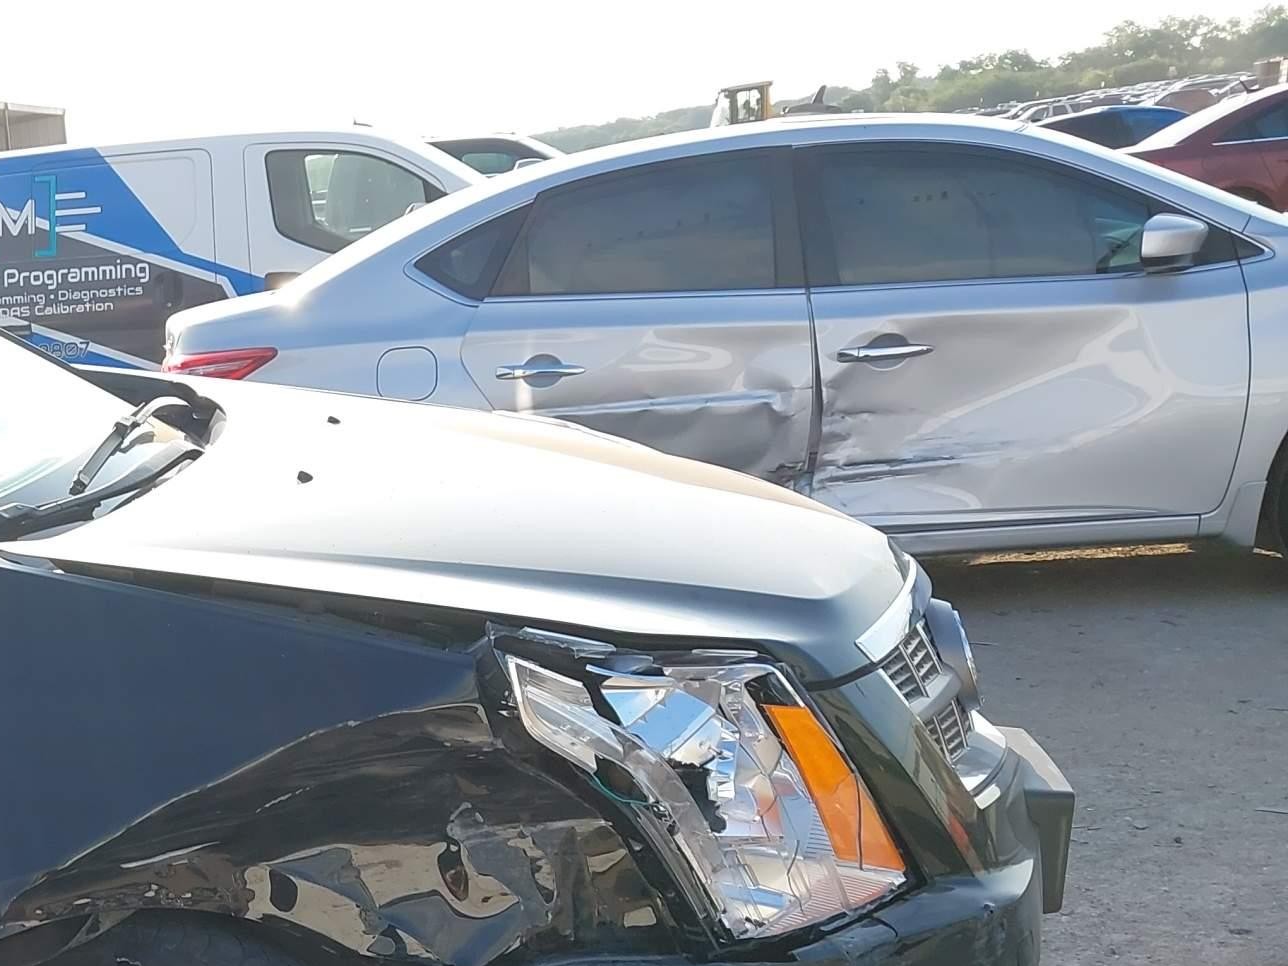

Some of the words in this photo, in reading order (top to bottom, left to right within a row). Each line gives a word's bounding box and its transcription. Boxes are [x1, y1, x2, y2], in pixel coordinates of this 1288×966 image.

[3, 258, 150, 289] Programming
[57, 284, 144, 302] Diagnostics
[34, 300, 114, 316] Calibration
